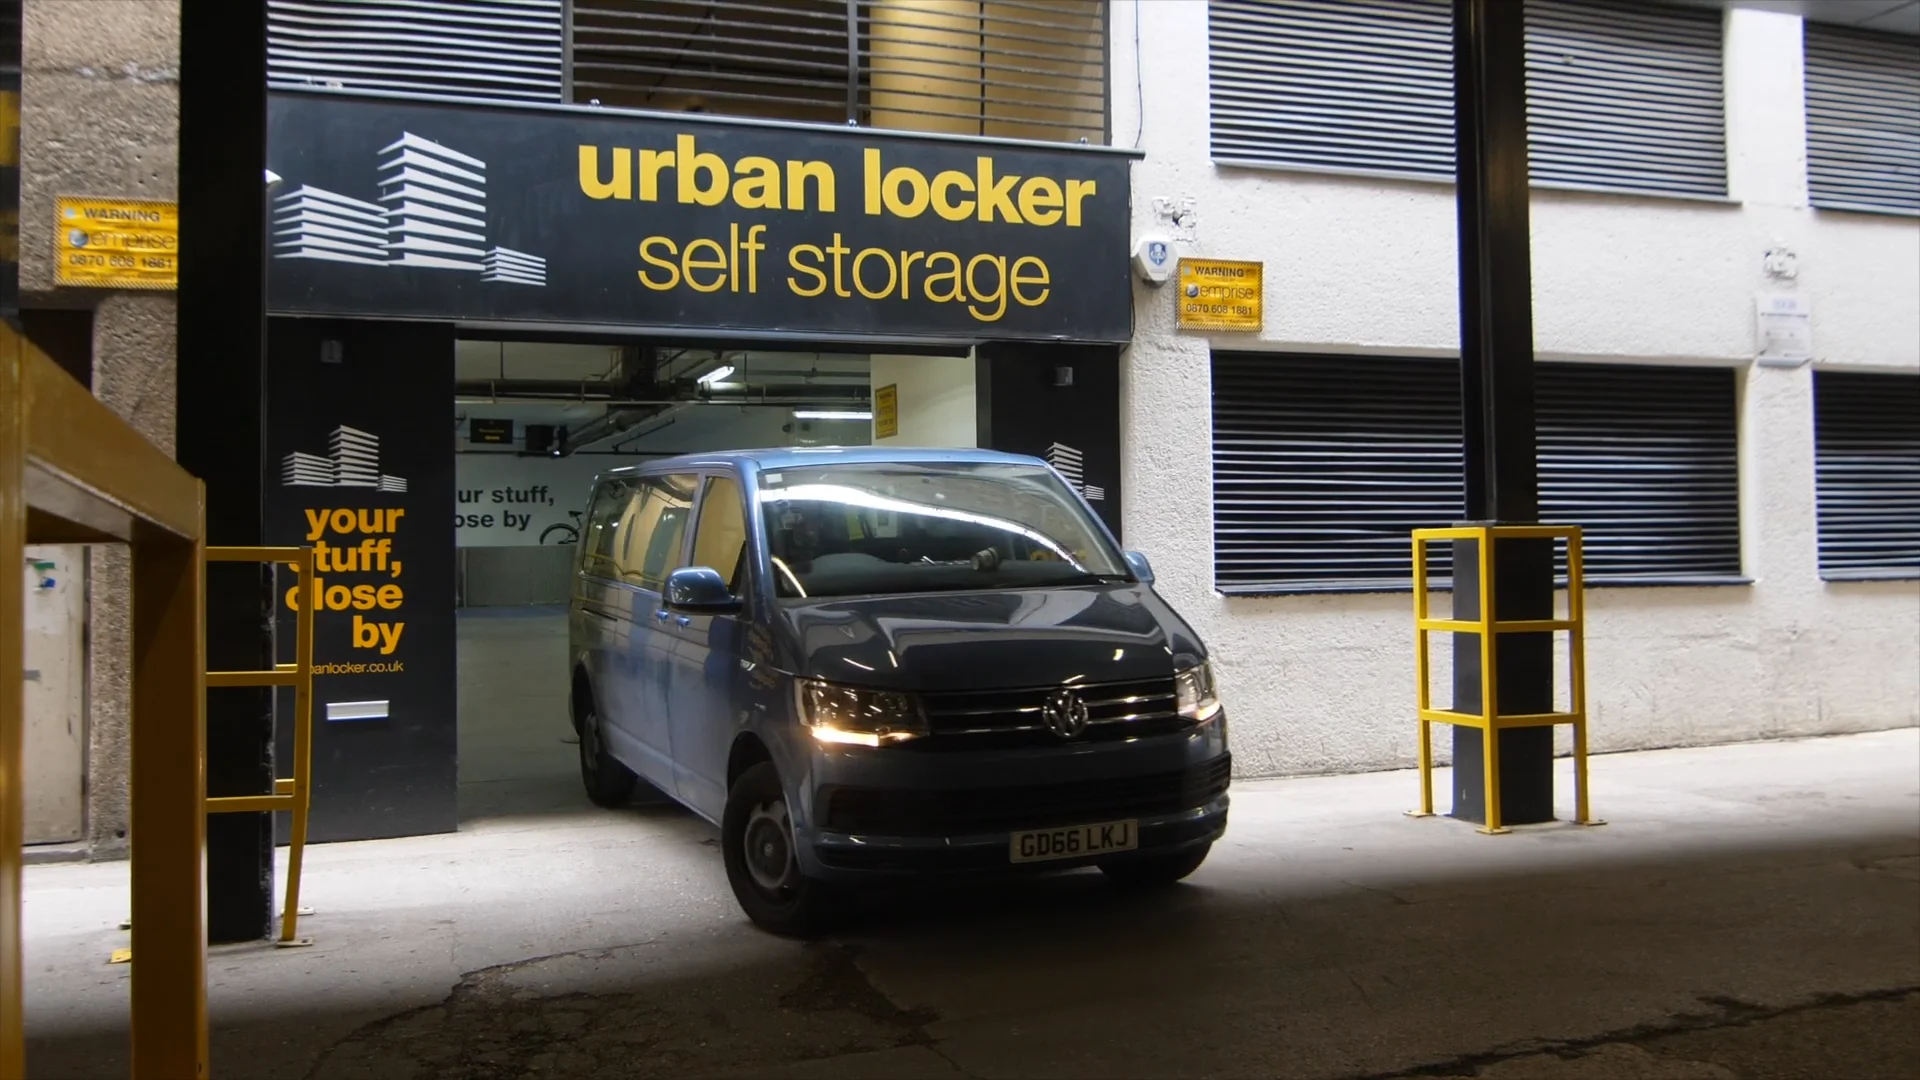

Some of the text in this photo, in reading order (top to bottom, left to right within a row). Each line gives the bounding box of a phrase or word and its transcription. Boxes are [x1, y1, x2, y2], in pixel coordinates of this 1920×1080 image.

[579, 134, 1096, 227] urban locker
[84, 207, 161, 222] WARNING
[91, 230, 175, 251] emprise
[69, 254, 104, 267] 0870
[638, 223, 1050, 321] self storage
[1195, 266, 1245, 277] WARNING
[1200, 284, 1254, 302] emprise
[1186, 303, 1253, 316] 0870 608 1881
[458, 486, 554, 507] ur stuff,
[305, 508, 405, 541] your
[455, 510, 531, 531] ose by
[288, 539, 403, 578] tuff,
[353, 615, 405, 655] by
[311, 661, 404, 675] anlocker.co.uk
[1020, 823, 1128, 858] GD66 LKJ
